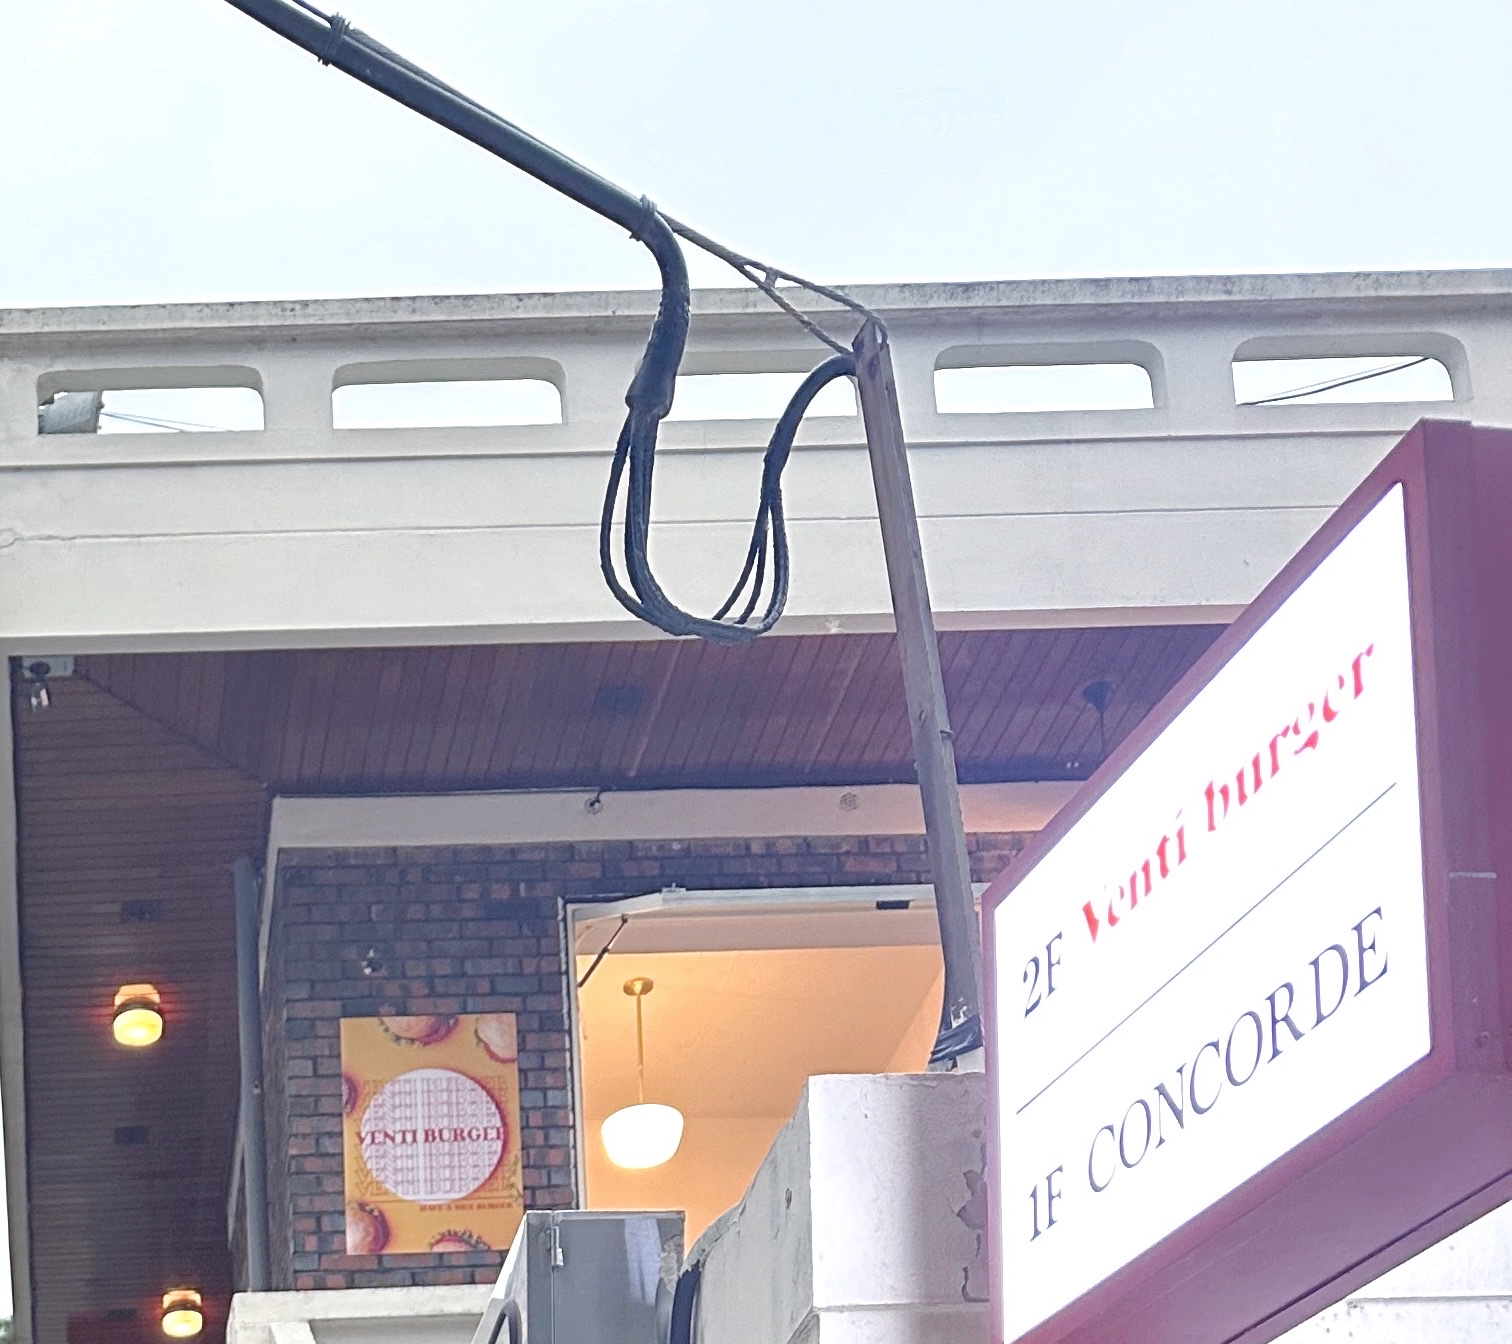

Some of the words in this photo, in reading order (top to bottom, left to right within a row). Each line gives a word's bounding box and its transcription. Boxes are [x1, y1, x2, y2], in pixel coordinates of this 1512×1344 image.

[1023, 931, 1063, 1019] 2F
[1082, 808, 1187, 944] Venti
[1204, 643, 1374, 833] burger
[355, 1129, 419, 1146] VENTI
[1028, 1164, 1064, 1242] 1F
[1088, 906, 1389, 1193] CONCORDE
